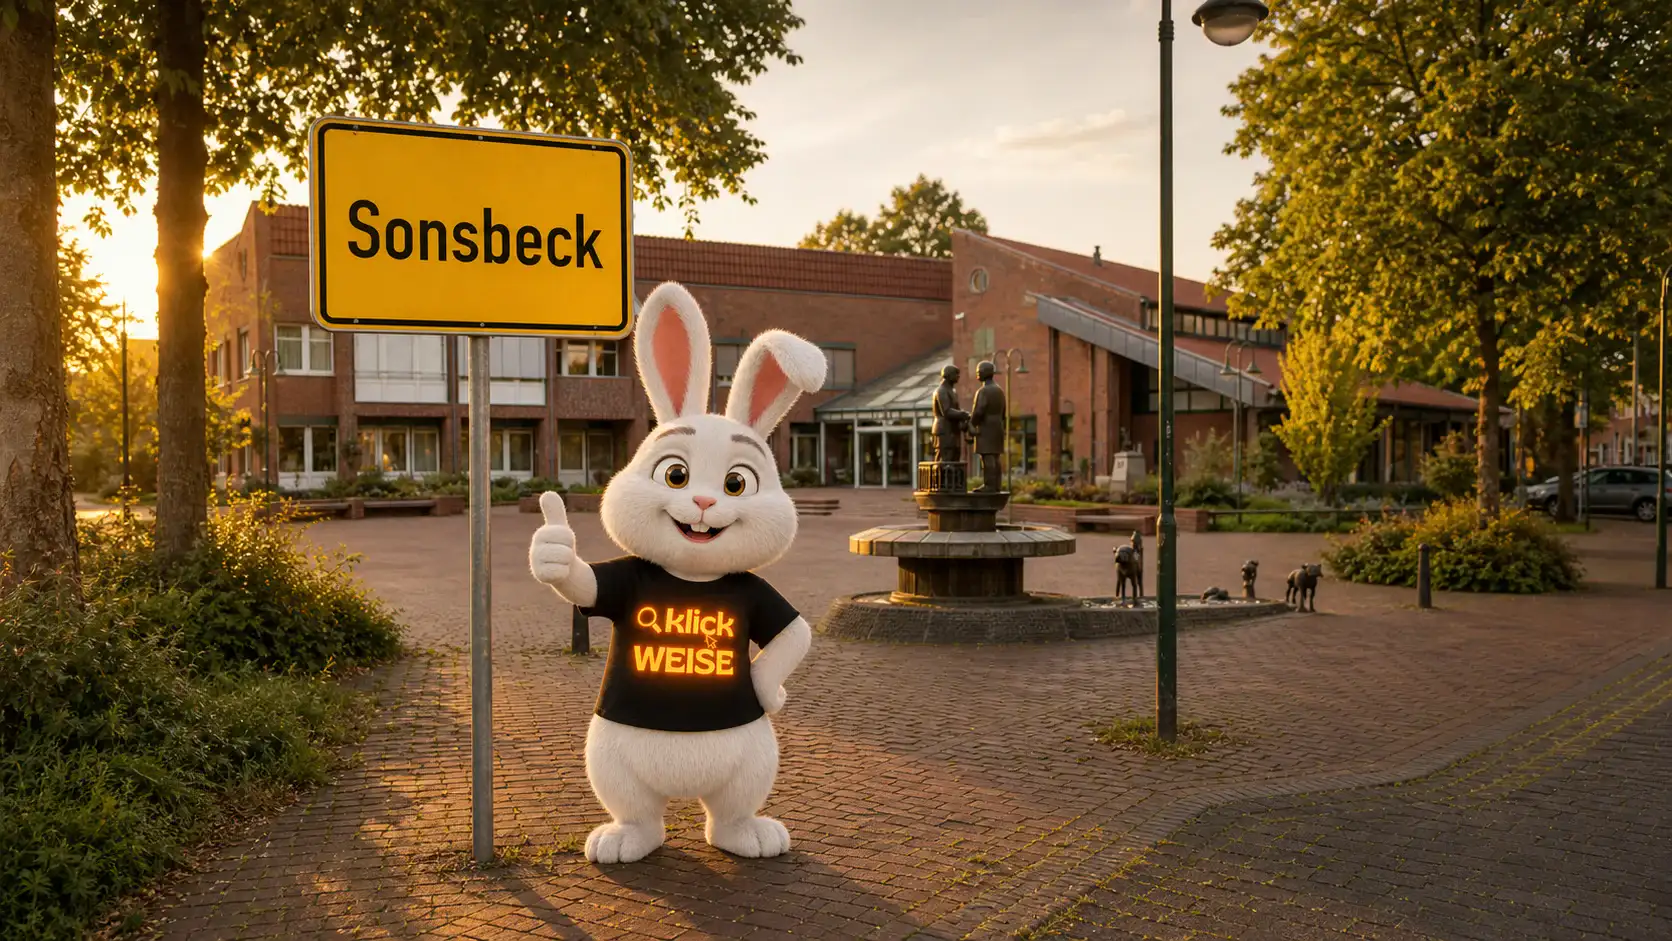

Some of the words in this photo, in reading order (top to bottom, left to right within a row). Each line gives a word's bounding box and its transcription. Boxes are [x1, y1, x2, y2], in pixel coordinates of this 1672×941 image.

[348, 199, 604, 269] Sonsbeck
[665, 608, 734, 637] klick
[634, 645, 734, 675] WEISE
